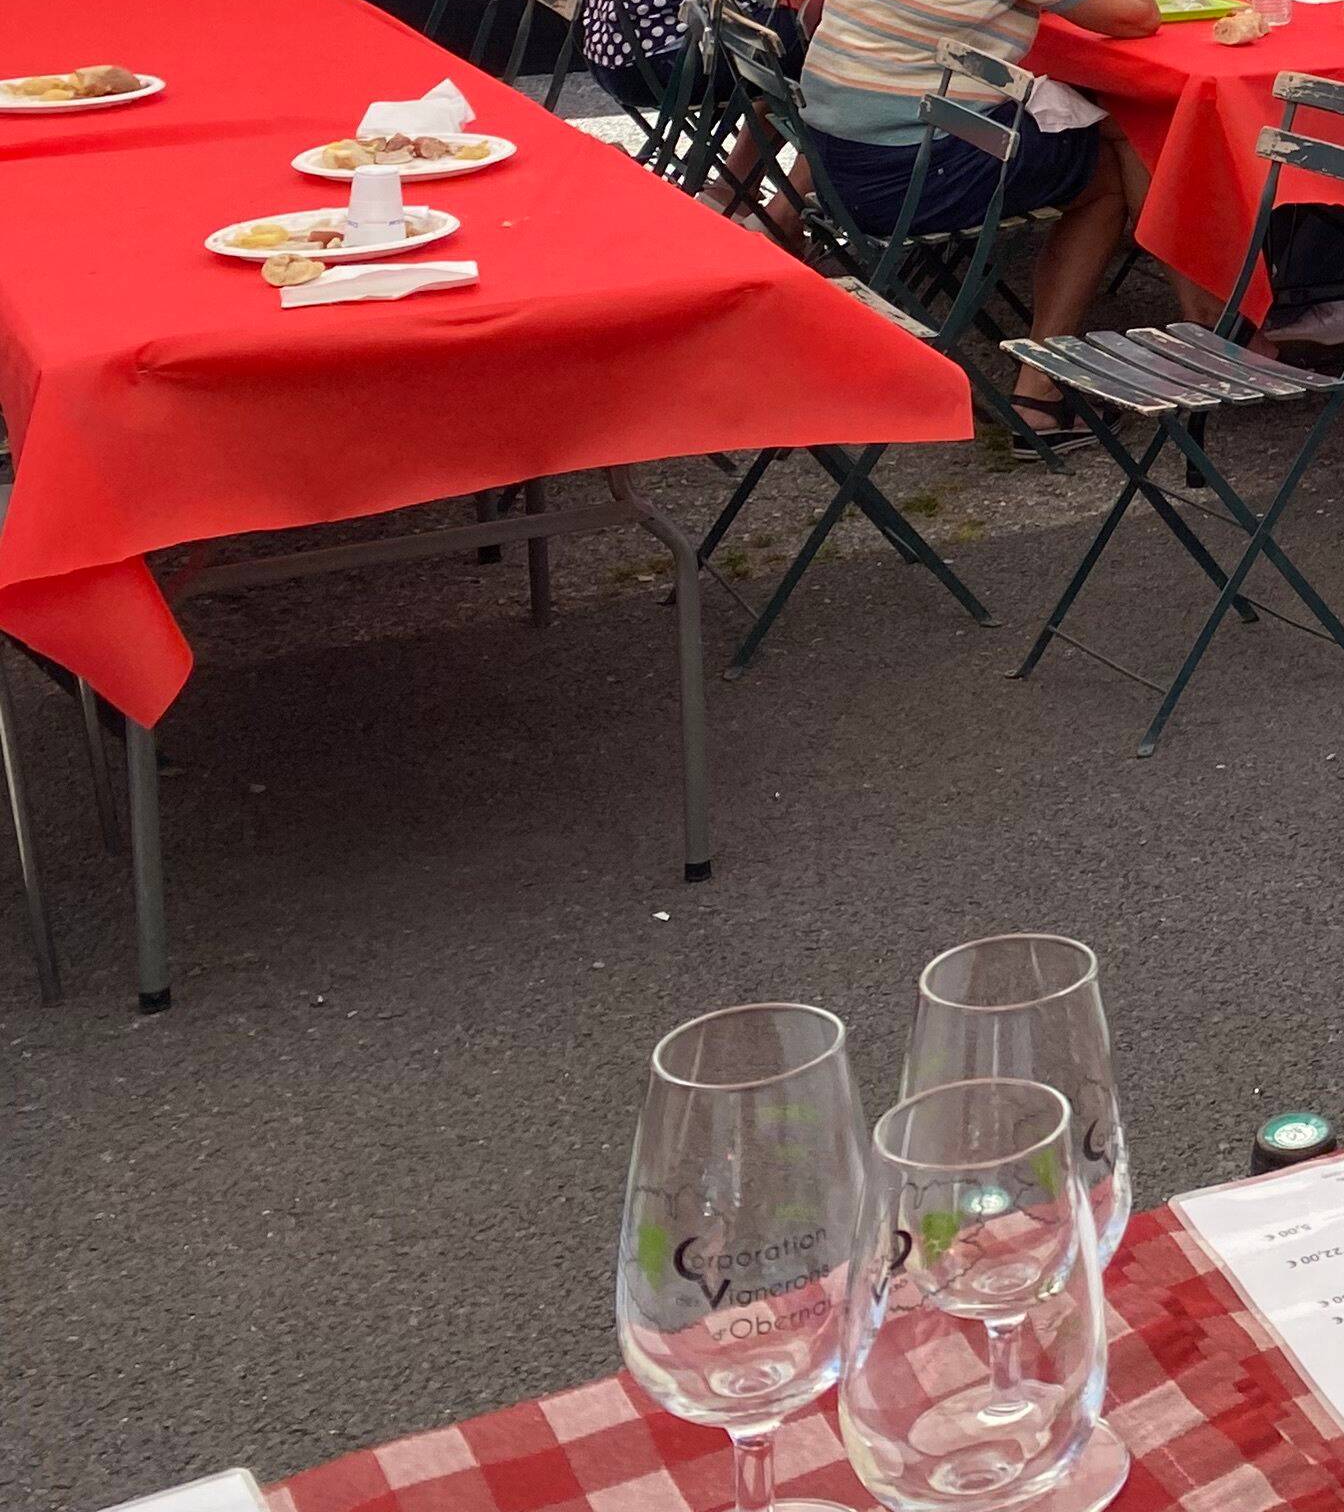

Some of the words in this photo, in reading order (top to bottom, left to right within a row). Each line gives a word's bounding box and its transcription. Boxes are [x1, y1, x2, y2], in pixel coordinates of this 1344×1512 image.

[1278, 1223, 1312, 1238] 5,00
[673, 1228, 827, 1281] Corporation
[1300, 1247, 1343, 1265] 22,00
[701, 1264, 829, 1309] Vignerons
